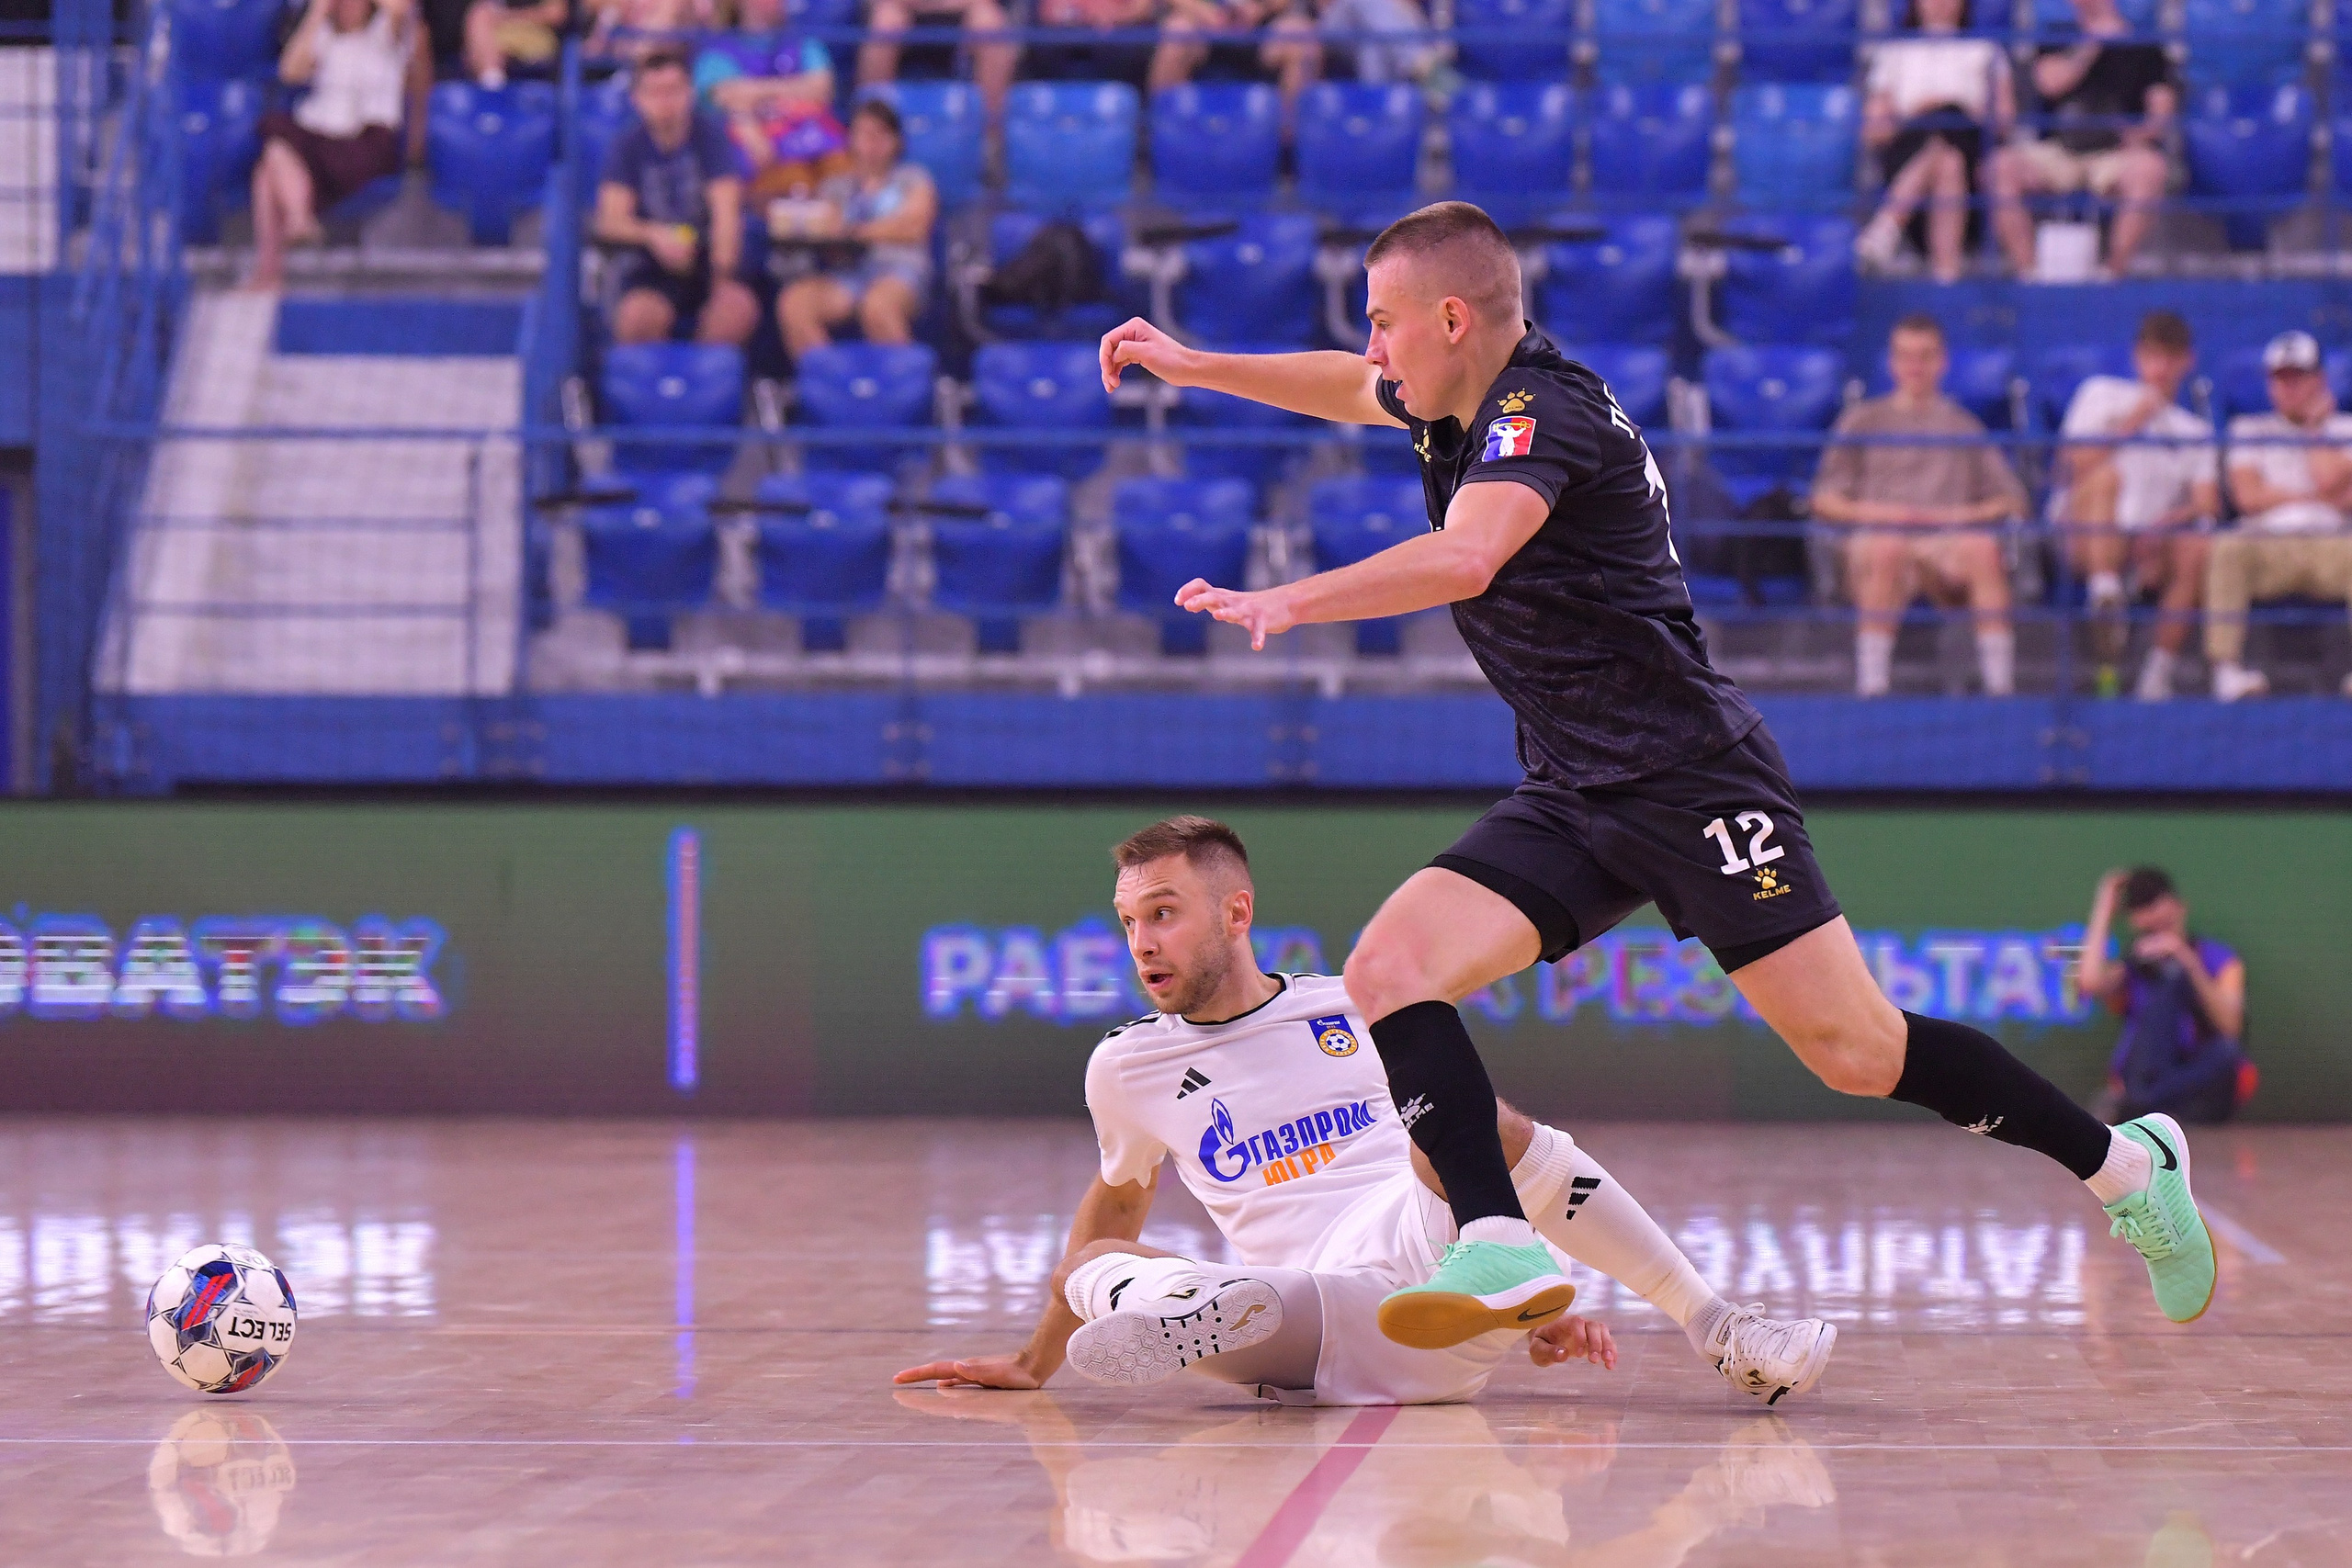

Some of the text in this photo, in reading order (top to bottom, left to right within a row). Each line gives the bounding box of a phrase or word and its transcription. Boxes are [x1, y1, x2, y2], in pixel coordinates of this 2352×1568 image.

[1702, 810, 1785, 875] 12
[1752, 884, 1792, 900] KELME
[1248, 1100, 1377, 1166] ГАЗПРОМ
[227, 1316, 292, 1341] SELECT
